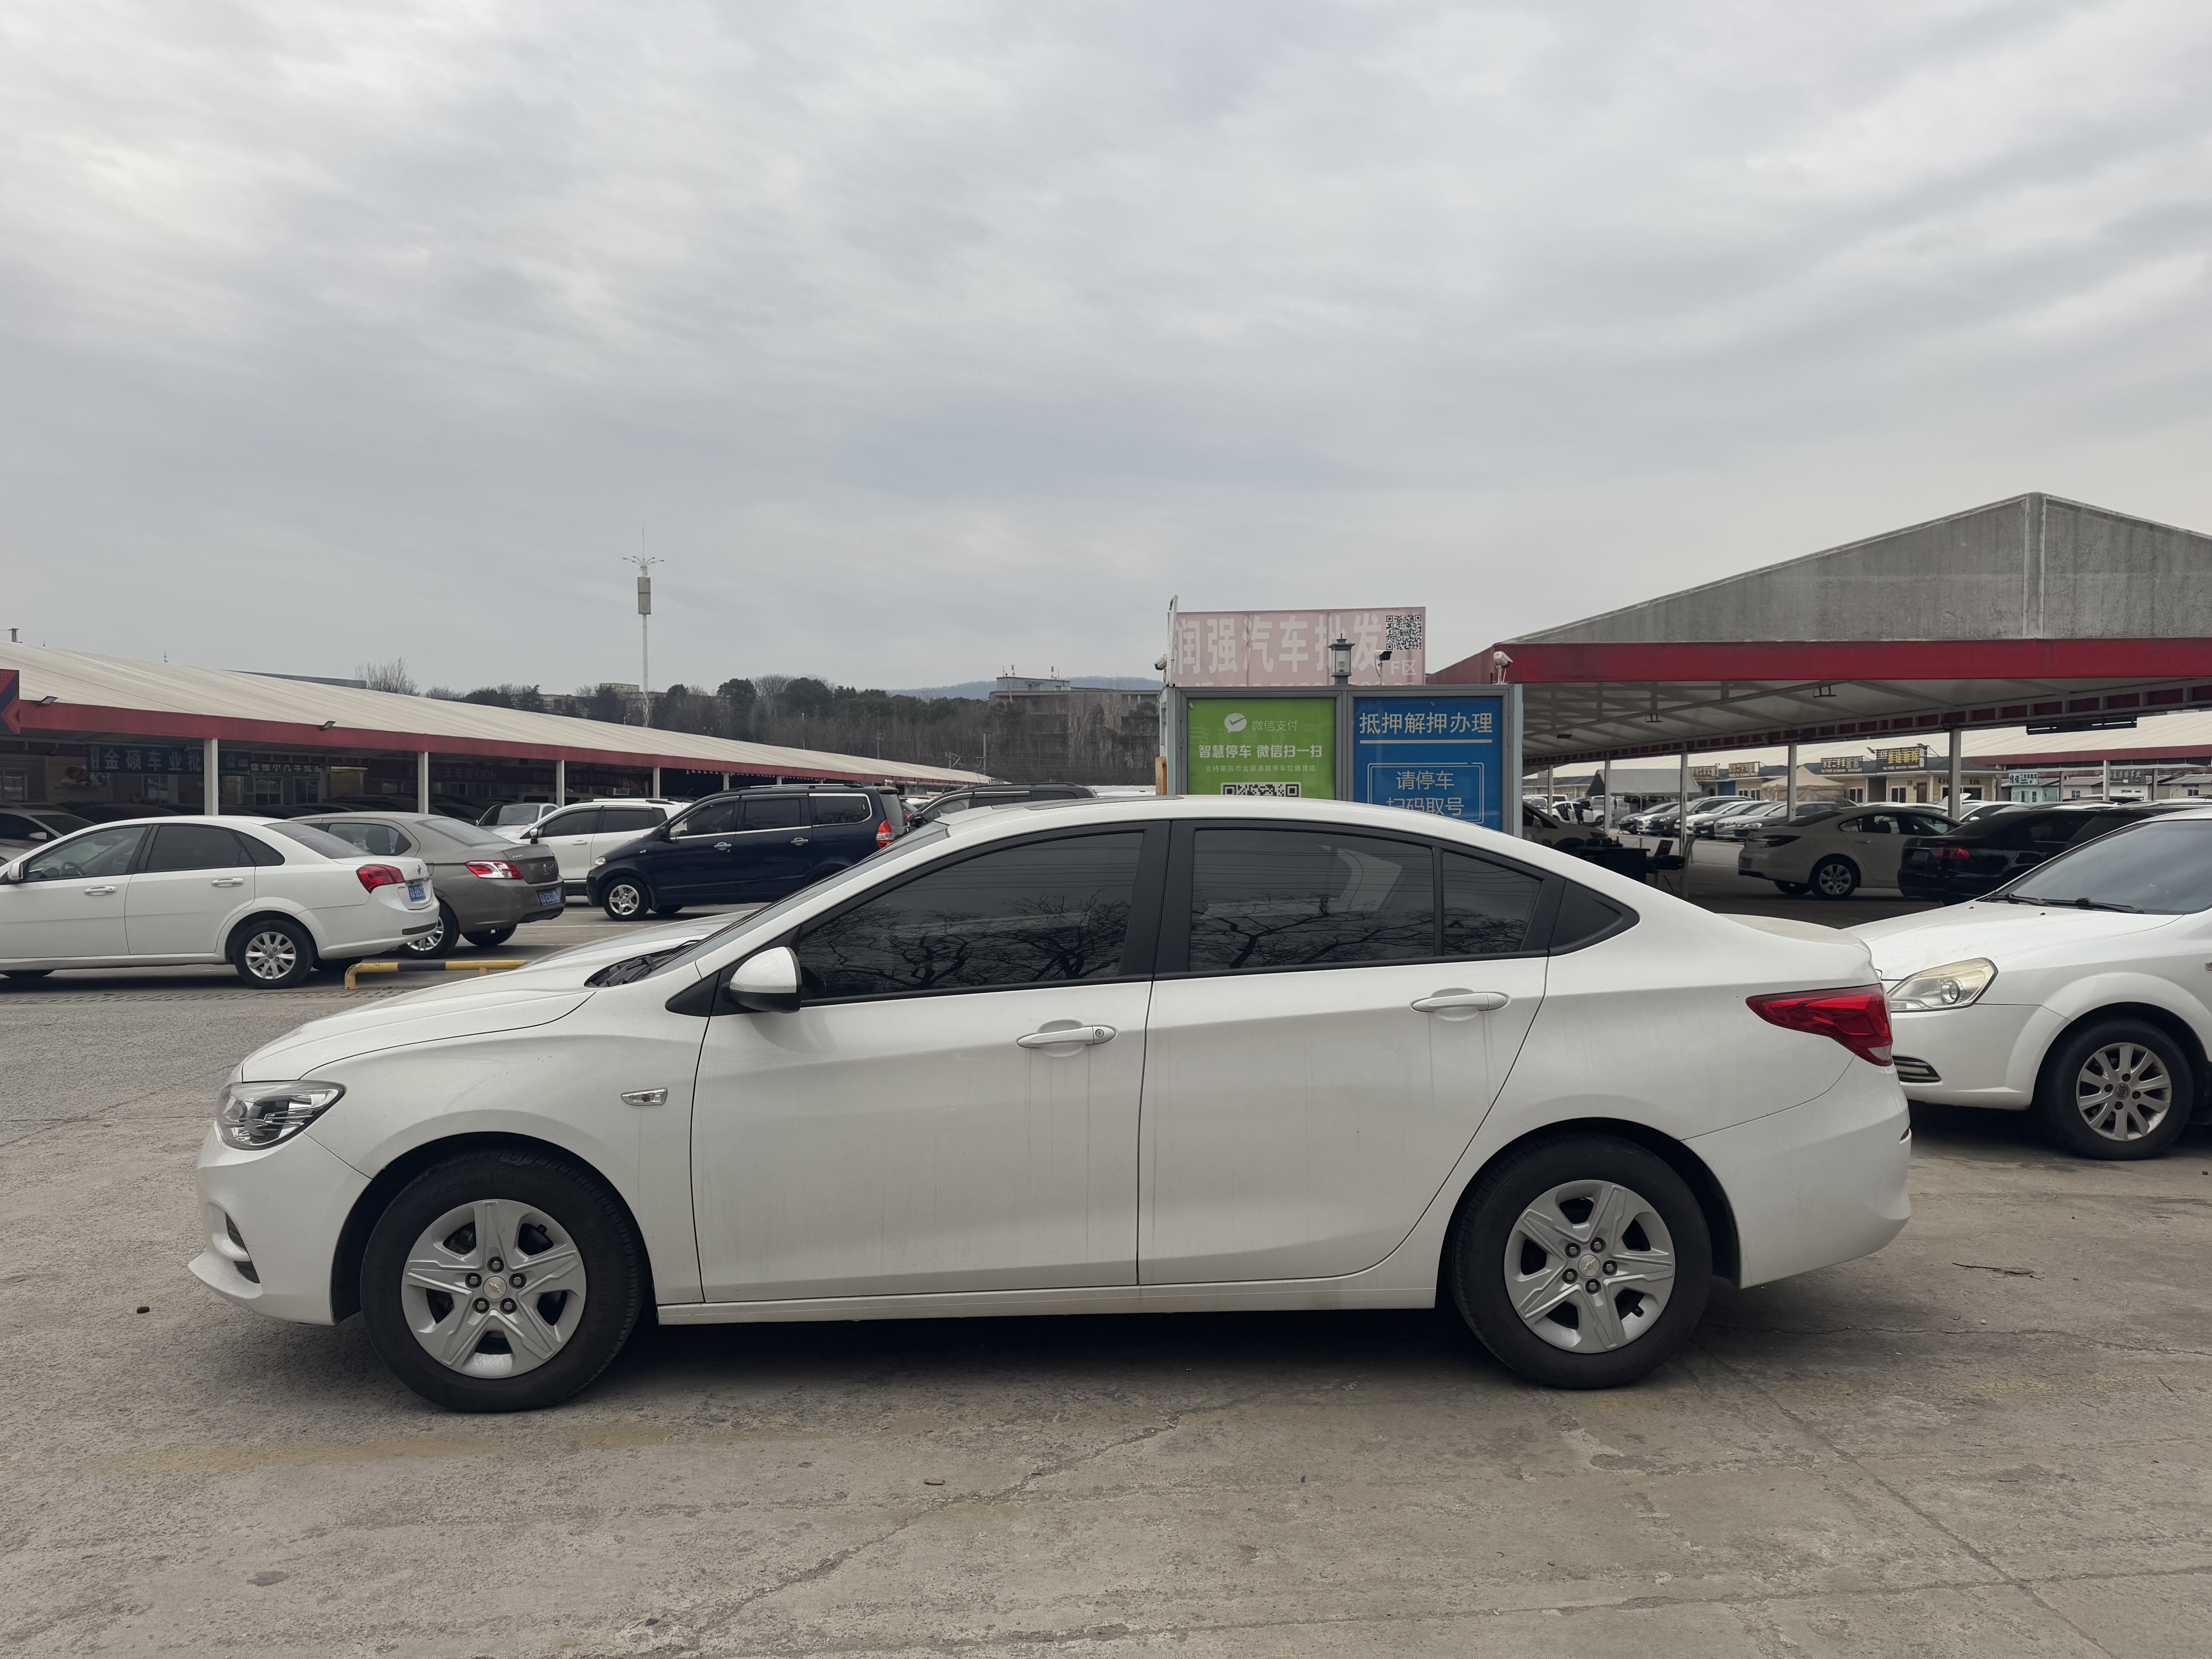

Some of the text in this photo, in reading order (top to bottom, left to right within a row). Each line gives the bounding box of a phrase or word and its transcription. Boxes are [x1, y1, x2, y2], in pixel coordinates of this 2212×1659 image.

[1173, 613, 1381, 674] 润强汽车批发
[1391, 660, 1417, 675] F区
[1252, 720, 1298, 731] 微信支付
[1359, 712, 1492, 734] 抵押解押办理
[1199, 744, 1322, 758] 智慧停车 微信扫一扫
[1396, 771, 1454, 790] 请停车
[1386, 797, 1464, 816] 扫码取号
